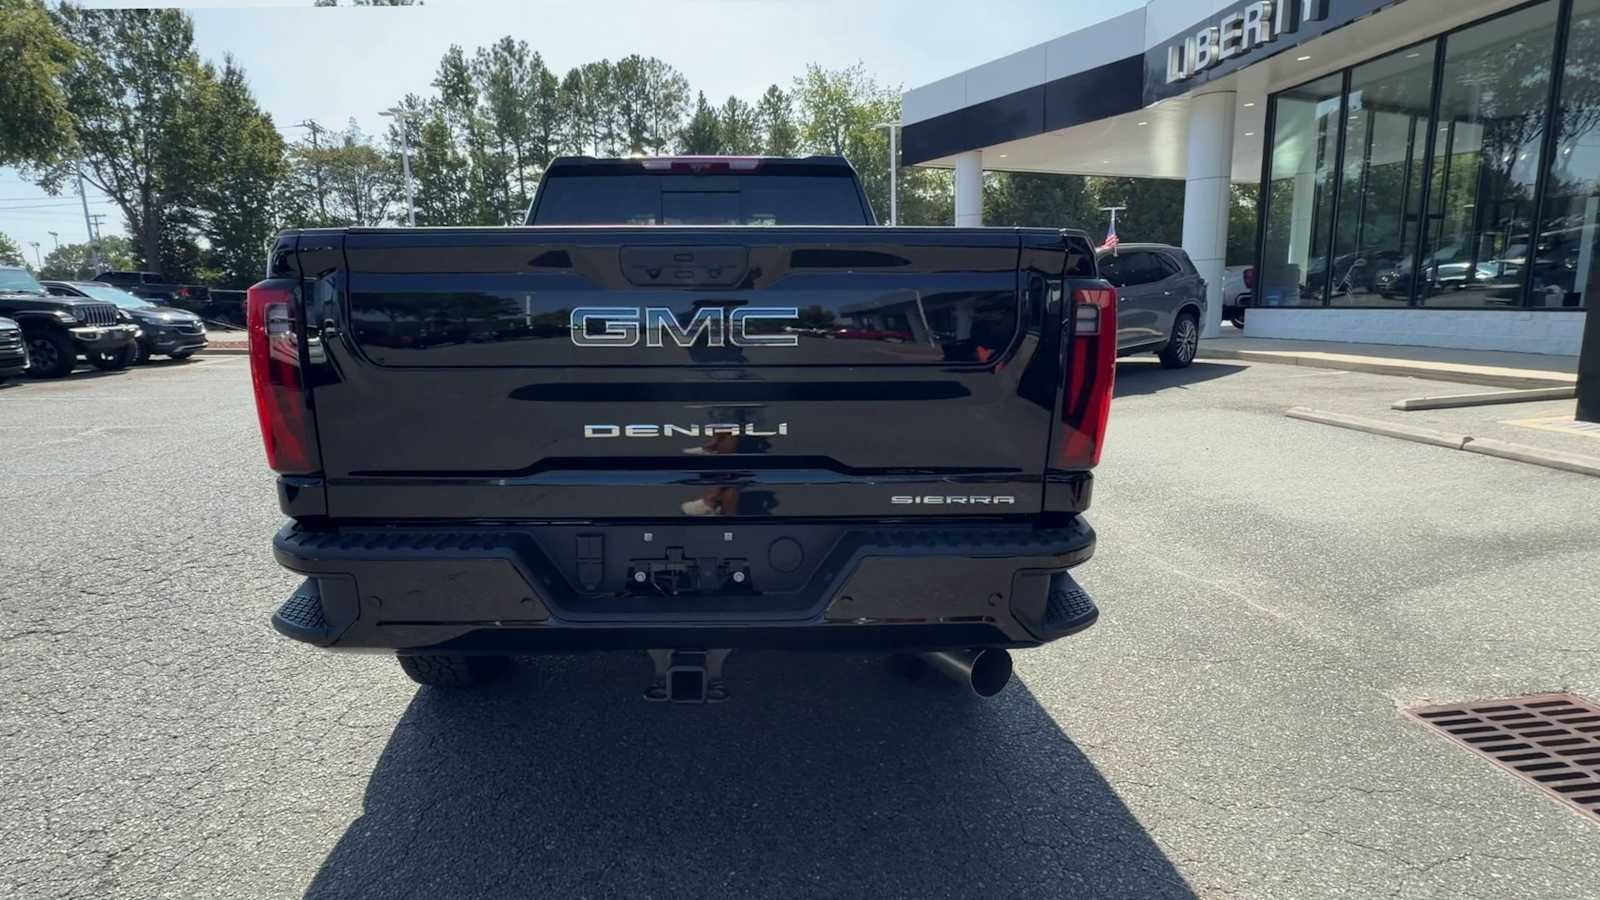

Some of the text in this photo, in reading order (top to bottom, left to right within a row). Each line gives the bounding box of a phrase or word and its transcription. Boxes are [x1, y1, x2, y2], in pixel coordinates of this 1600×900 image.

[570, 307, 799, 347] GMC
[584, 423, 788, 438] DENALI
[891, 496, 1015, 504] SIERRA
